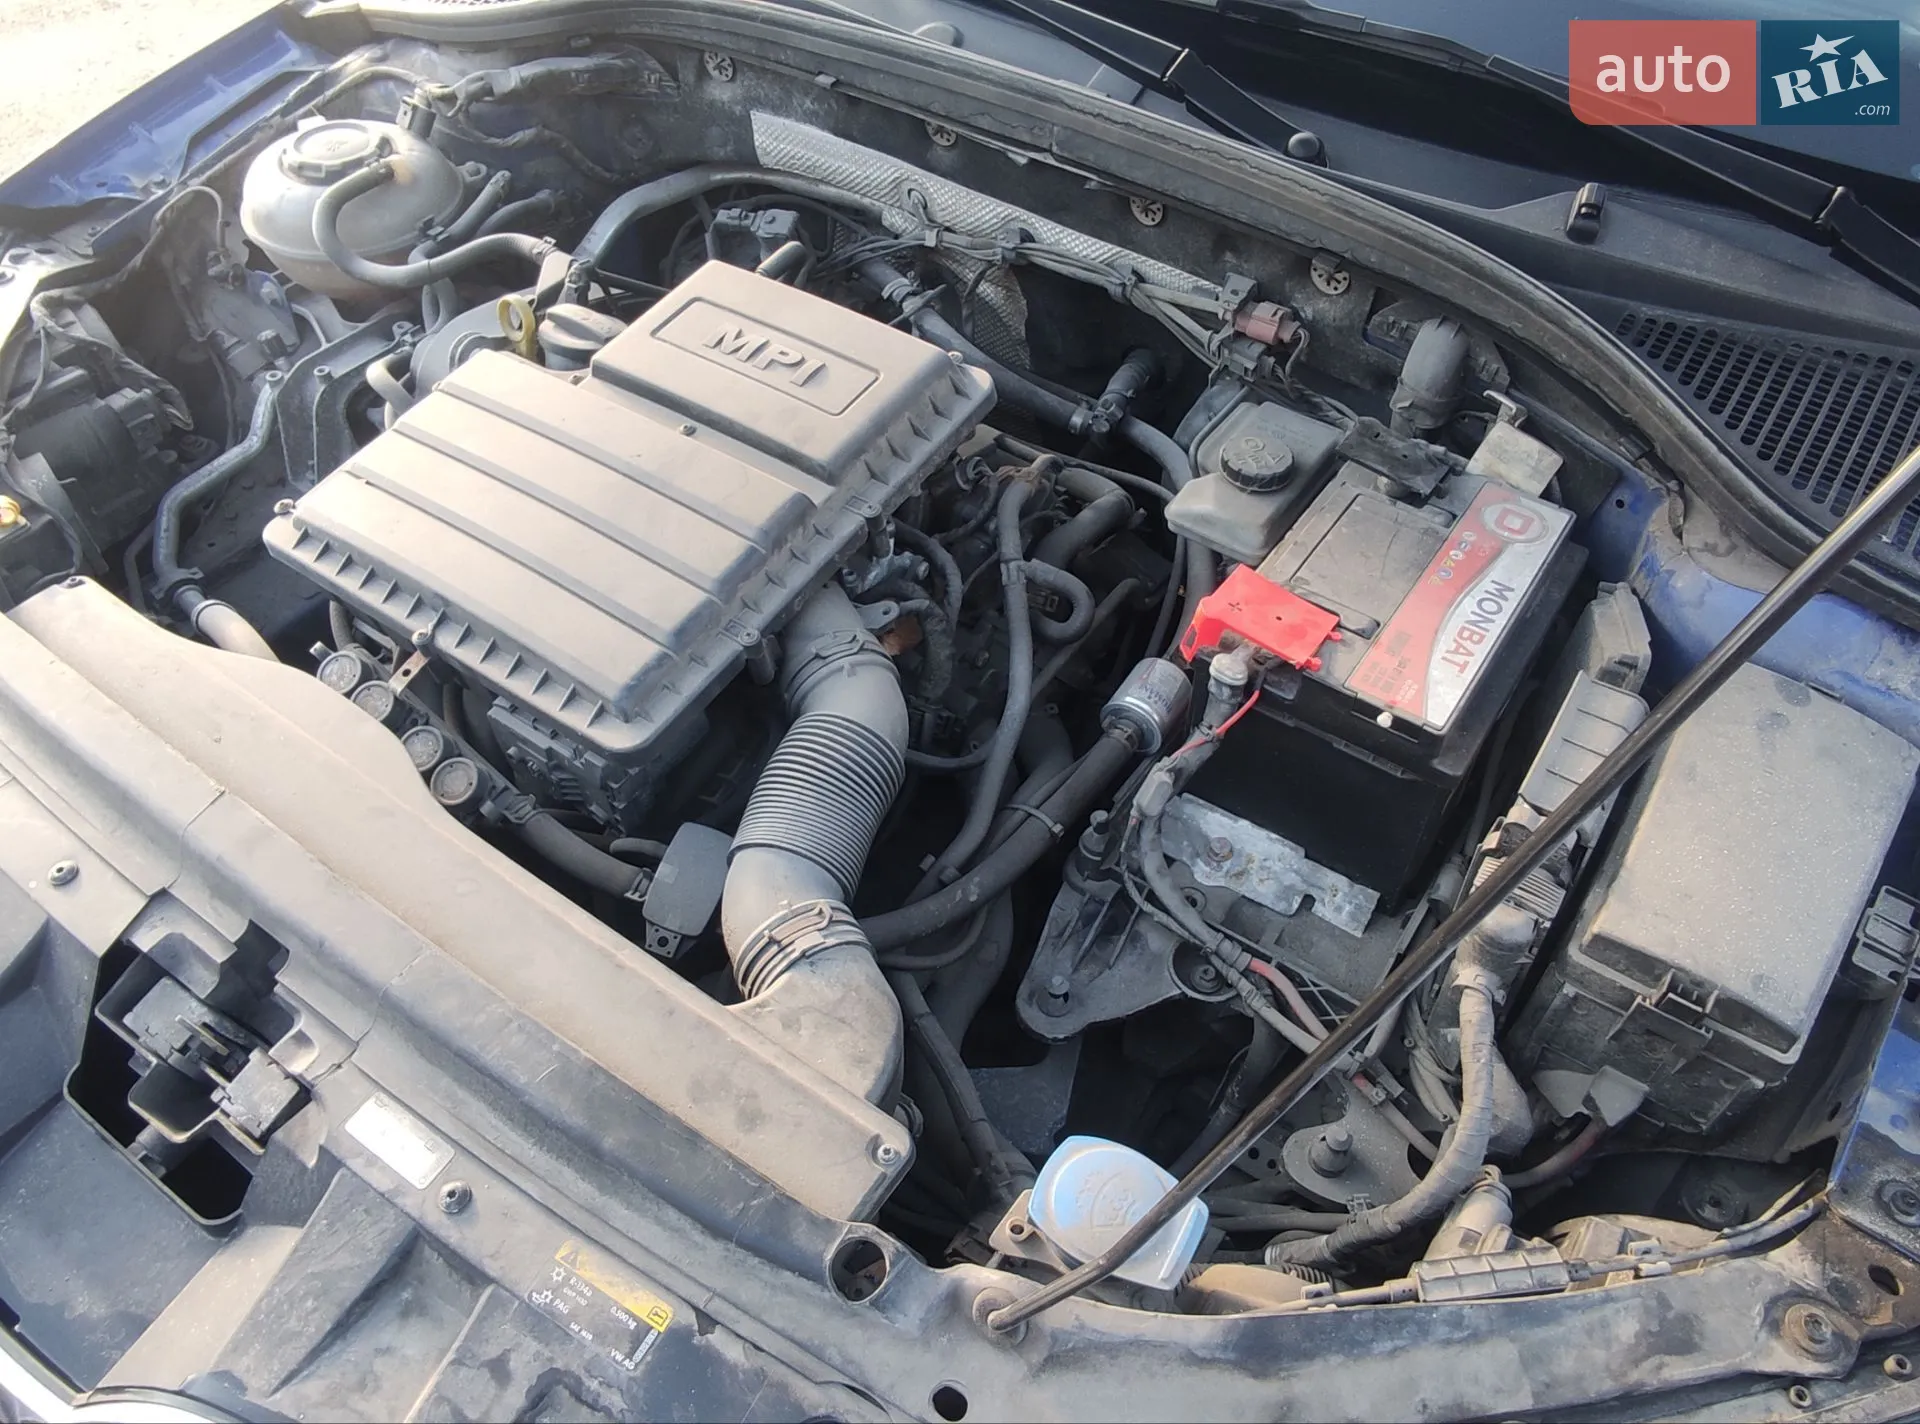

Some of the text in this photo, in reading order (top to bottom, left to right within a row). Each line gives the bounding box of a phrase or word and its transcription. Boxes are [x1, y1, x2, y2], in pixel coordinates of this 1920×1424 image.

[702, 323, 827, 388] MPI
[1441, 579, 1516, 675] MONBAT
[553, 1299, 569, 1314] PAG
[569, 1277, 593, 1296] R-134a
[627, 1317, 638, 1330] kg
[610, 1349, 635, 1370] VW AG
